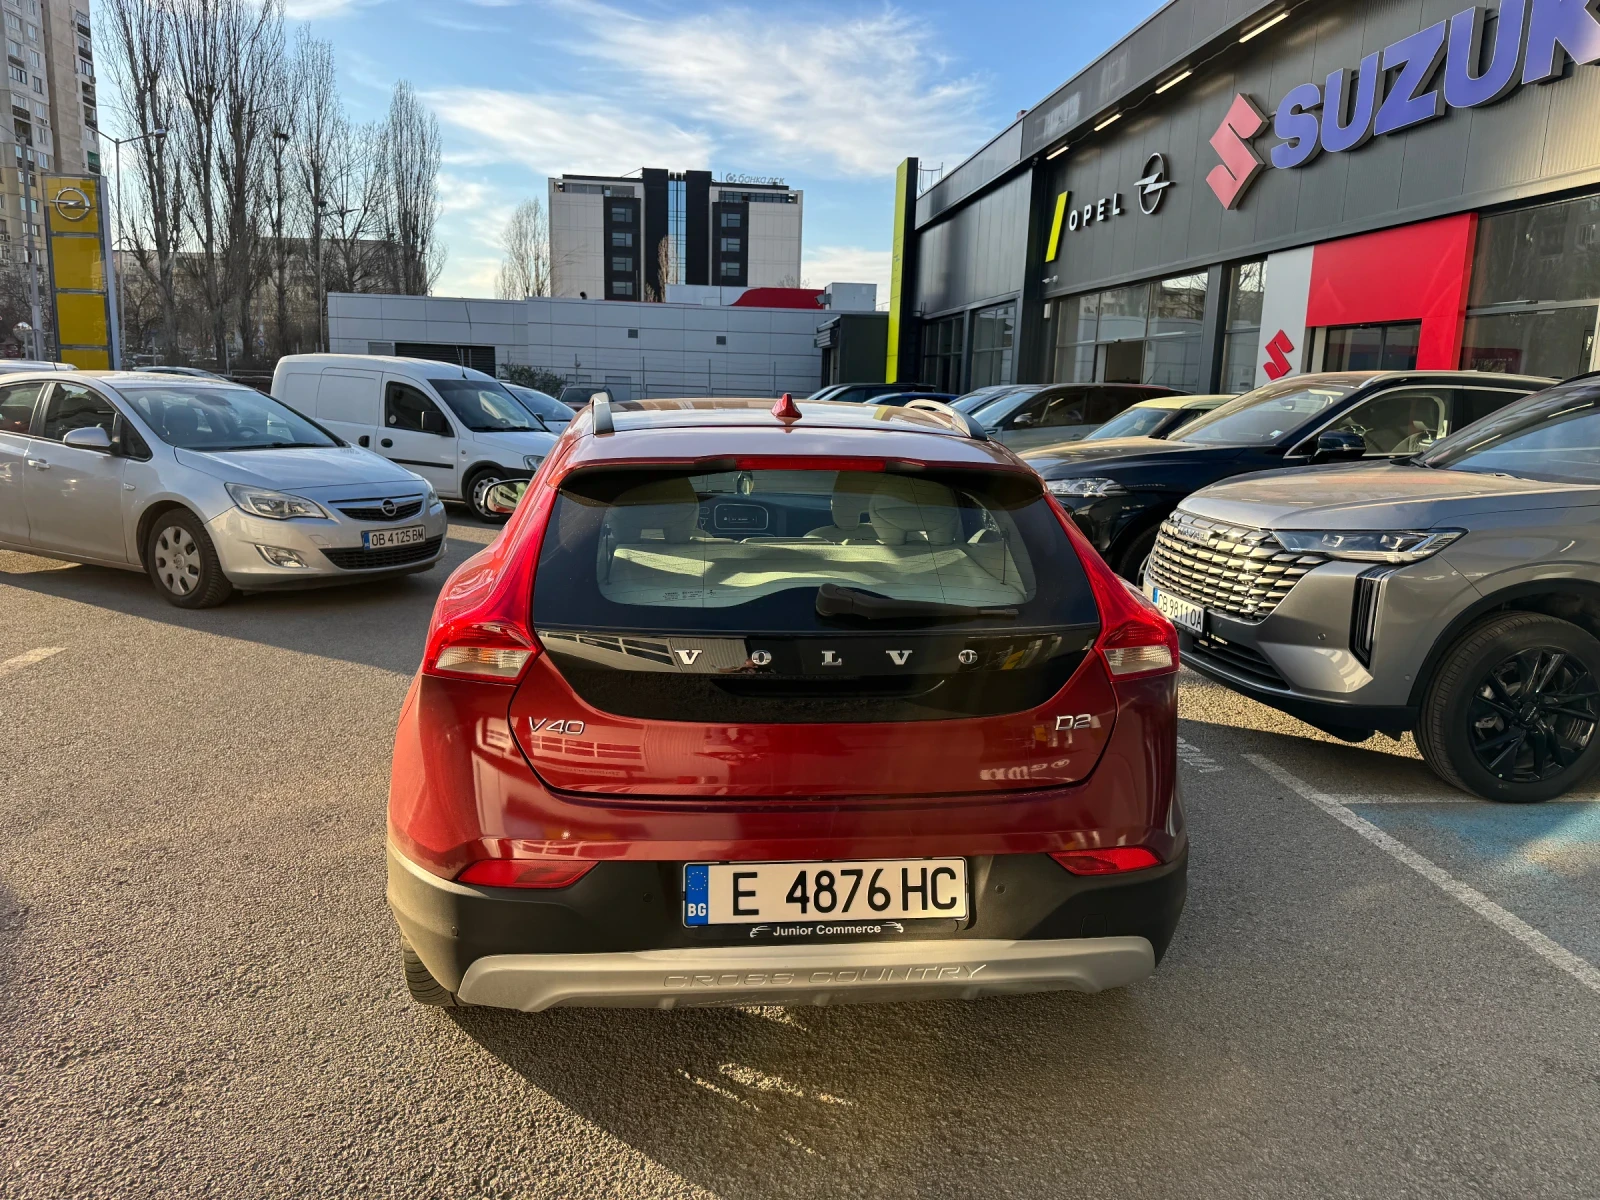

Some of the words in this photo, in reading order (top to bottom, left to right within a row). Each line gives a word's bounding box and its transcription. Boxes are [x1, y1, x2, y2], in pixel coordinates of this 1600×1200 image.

[738, 173, 767, 184] банка
[1069, 193, 1121, 231] OPEL
[371, 534, 386, 547] OB
[387, 530, 411, 544] 4125
[412, 528, 424, 541] BM
[1158, 594, 1168, 613] CB
[1169, 599, 1188, 624] 9811
[1190, 608, 1202, 631] OA
[675, 649, 978, 666] VOLVO
[528, 716, 585, 735] V40
[1055, 713, 1092, 731] D2
[733, 872, 759, 916] E
[785, 868, 891, 915] 4876
[901, 866, 957, 911] HC
[687, 903, 707, 917] BG
[773, 925, 814, 937] Junior
[816, 924, 882, 936] Commerce
[663, 972, 795, 988] CROSS
[808, 964, 988, 985] COUNTRY
